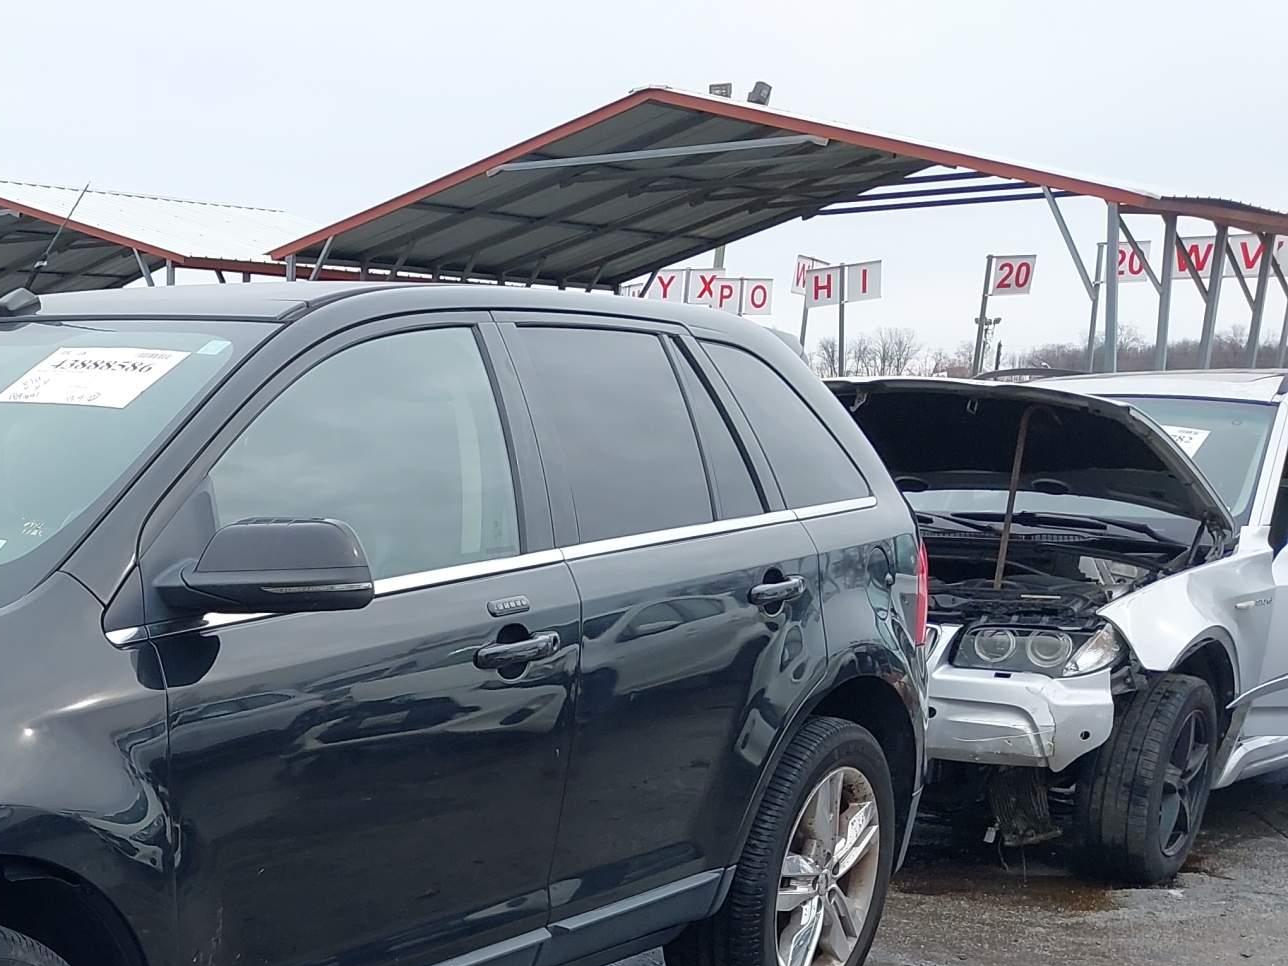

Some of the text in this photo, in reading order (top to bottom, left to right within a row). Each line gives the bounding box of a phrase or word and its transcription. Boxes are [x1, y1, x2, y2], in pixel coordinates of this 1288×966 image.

[1175, 243, 1214, 272] W
[697, 275, 717, 298] X
[996, 262, 1031, 288] 20
[657, 276, 675, 298] Y
[719, 285, 733, 308] P
[751, 285, 767, 308] O
[814, 274, 831, 300] H
[51, 359, 153, 374] 43888586
